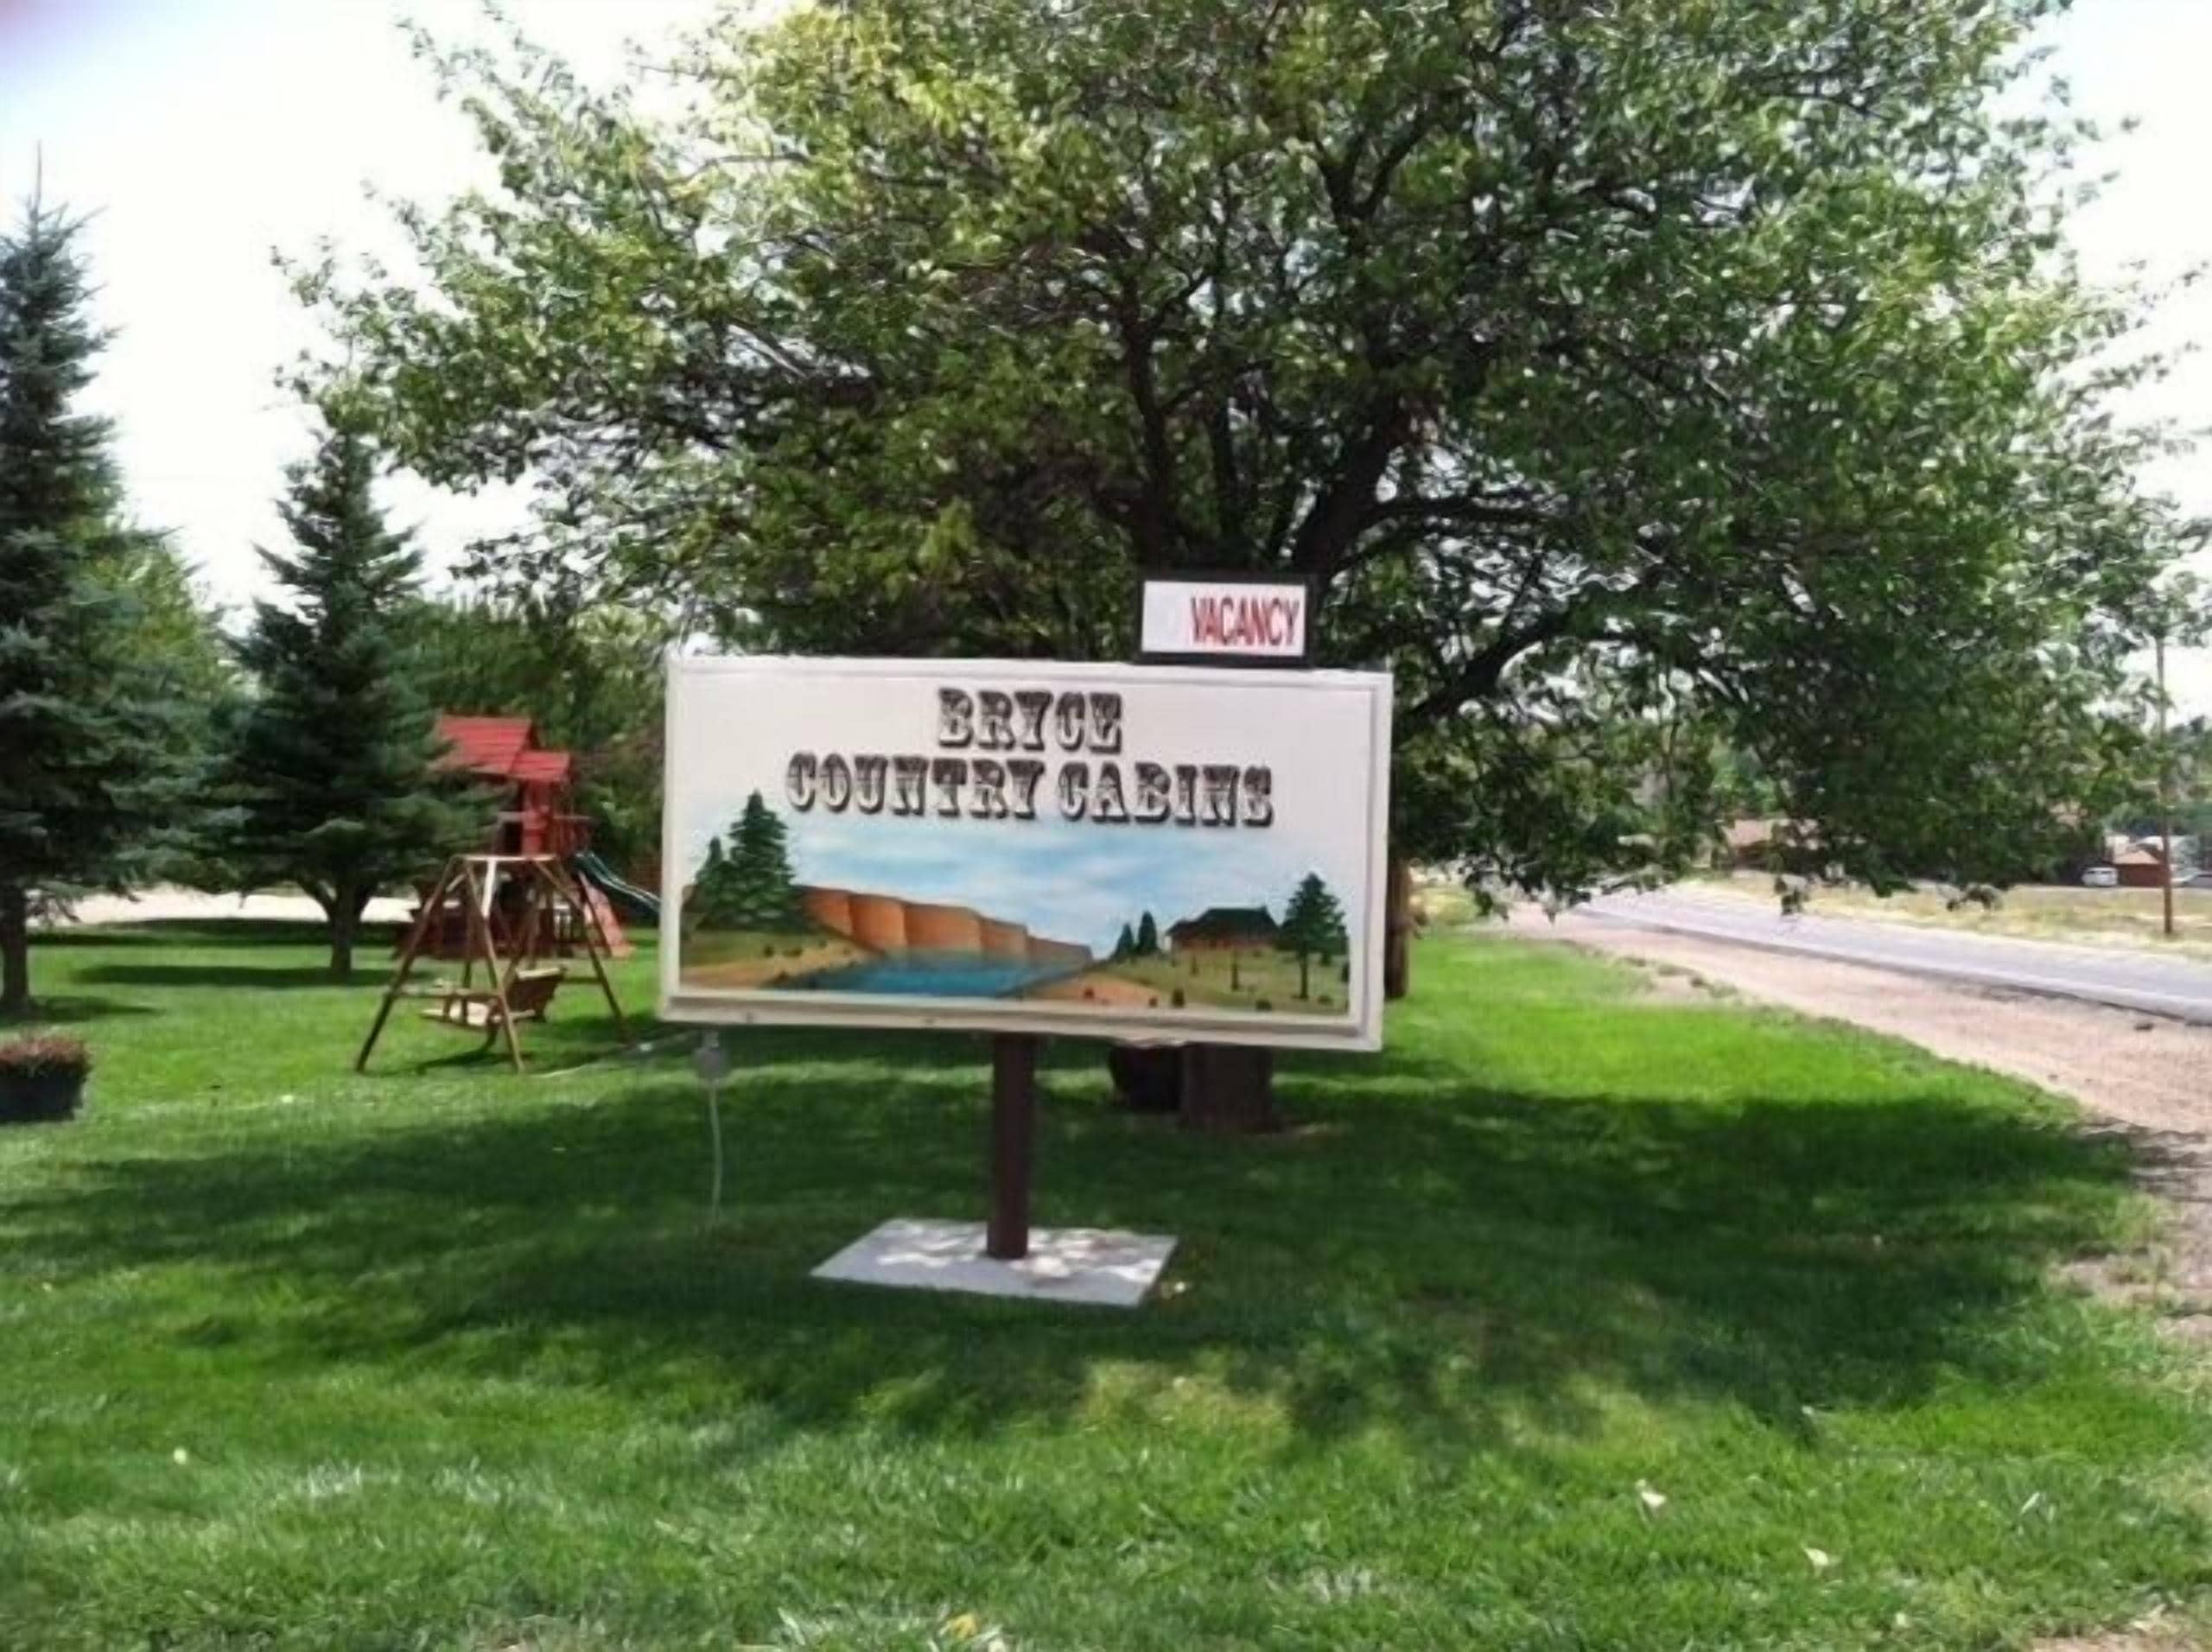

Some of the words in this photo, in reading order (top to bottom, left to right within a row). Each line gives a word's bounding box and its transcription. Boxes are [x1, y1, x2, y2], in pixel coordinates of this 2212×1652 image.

[1190, 595, 1300, 646] VACANCY
[938, 687, 1123, 754] BRYCE
[786, 753, 1044, 820] COUNTRY
[1058, 760, 1274, 828] CABINS
